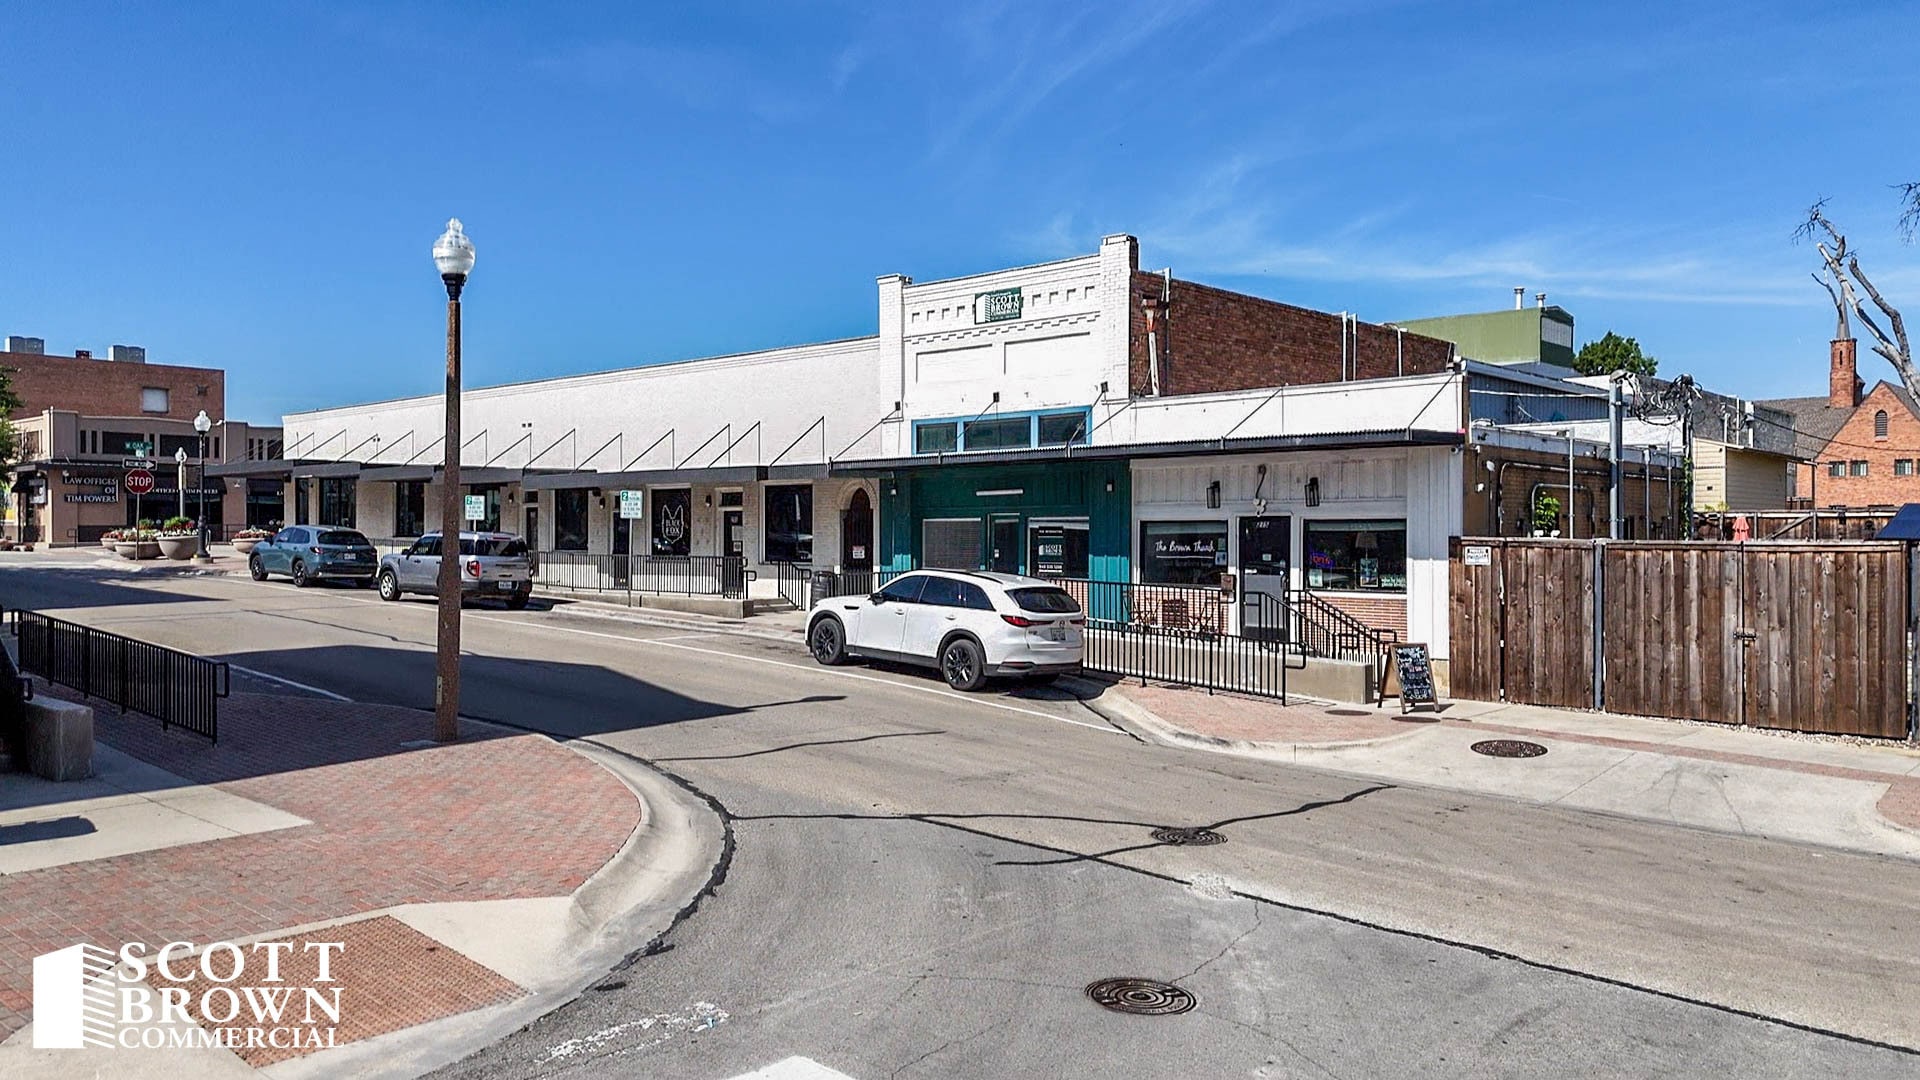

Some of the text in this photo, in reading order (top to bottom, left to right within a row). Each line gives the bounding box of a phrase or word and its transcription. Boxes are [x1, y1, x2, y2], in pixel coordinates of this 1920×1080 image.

[990, 293, 1020, 304] SCOTT
[128, 476, 152, 487] STOP
[622, 492, 628, 500] 2
[665, 527, 680, 535] FOX
[1155, 540, 1167, 552] The
